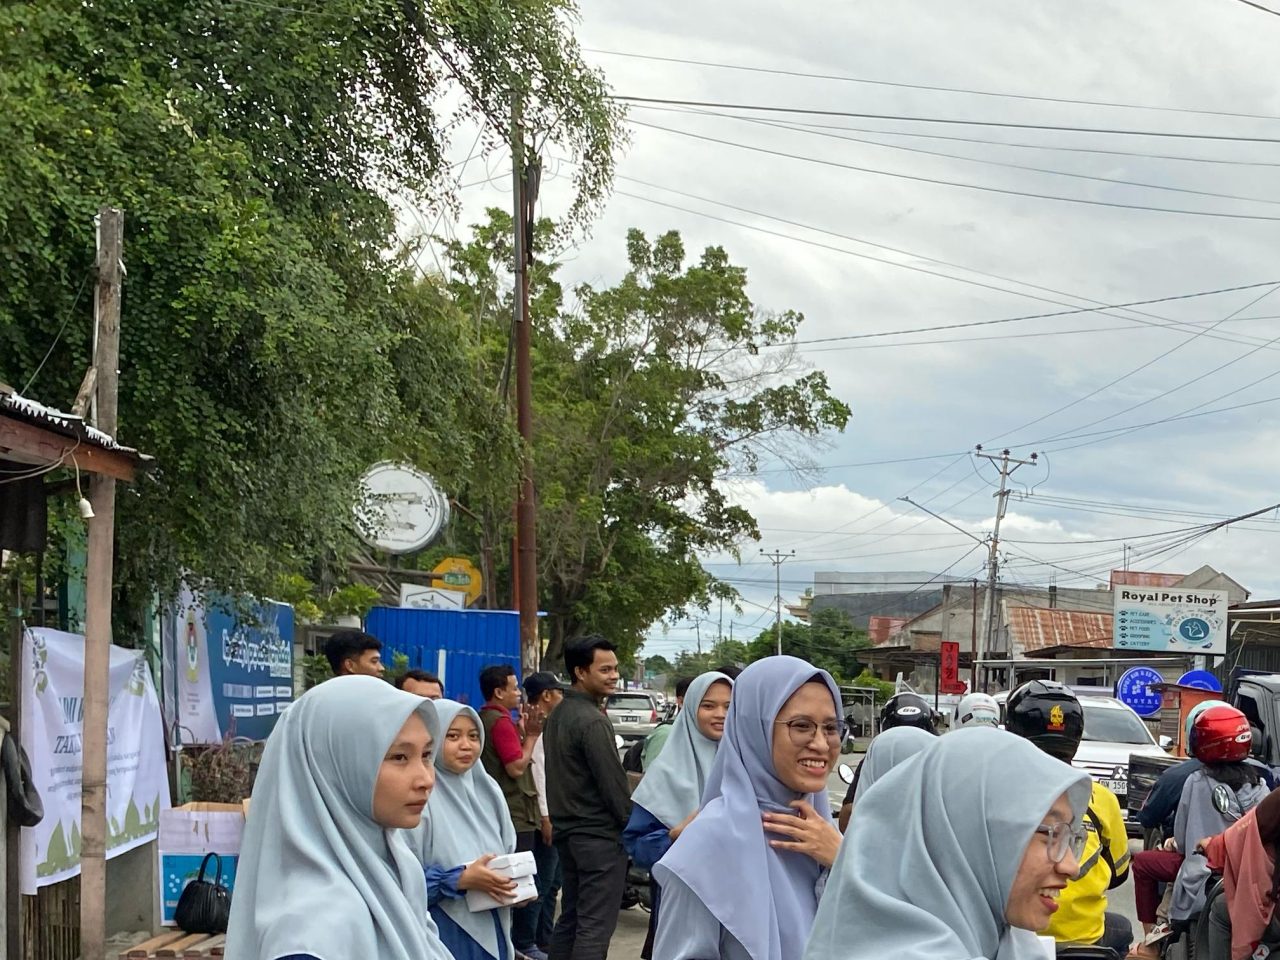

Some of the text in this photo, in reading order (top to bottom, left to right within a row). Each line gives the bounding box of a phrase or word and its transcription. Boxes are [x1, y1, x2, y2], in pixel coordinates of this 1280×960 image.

[1122, 591, 1217, 607] Royal Pet Shop
[1126, 697, 1159, 705] ROYAL
